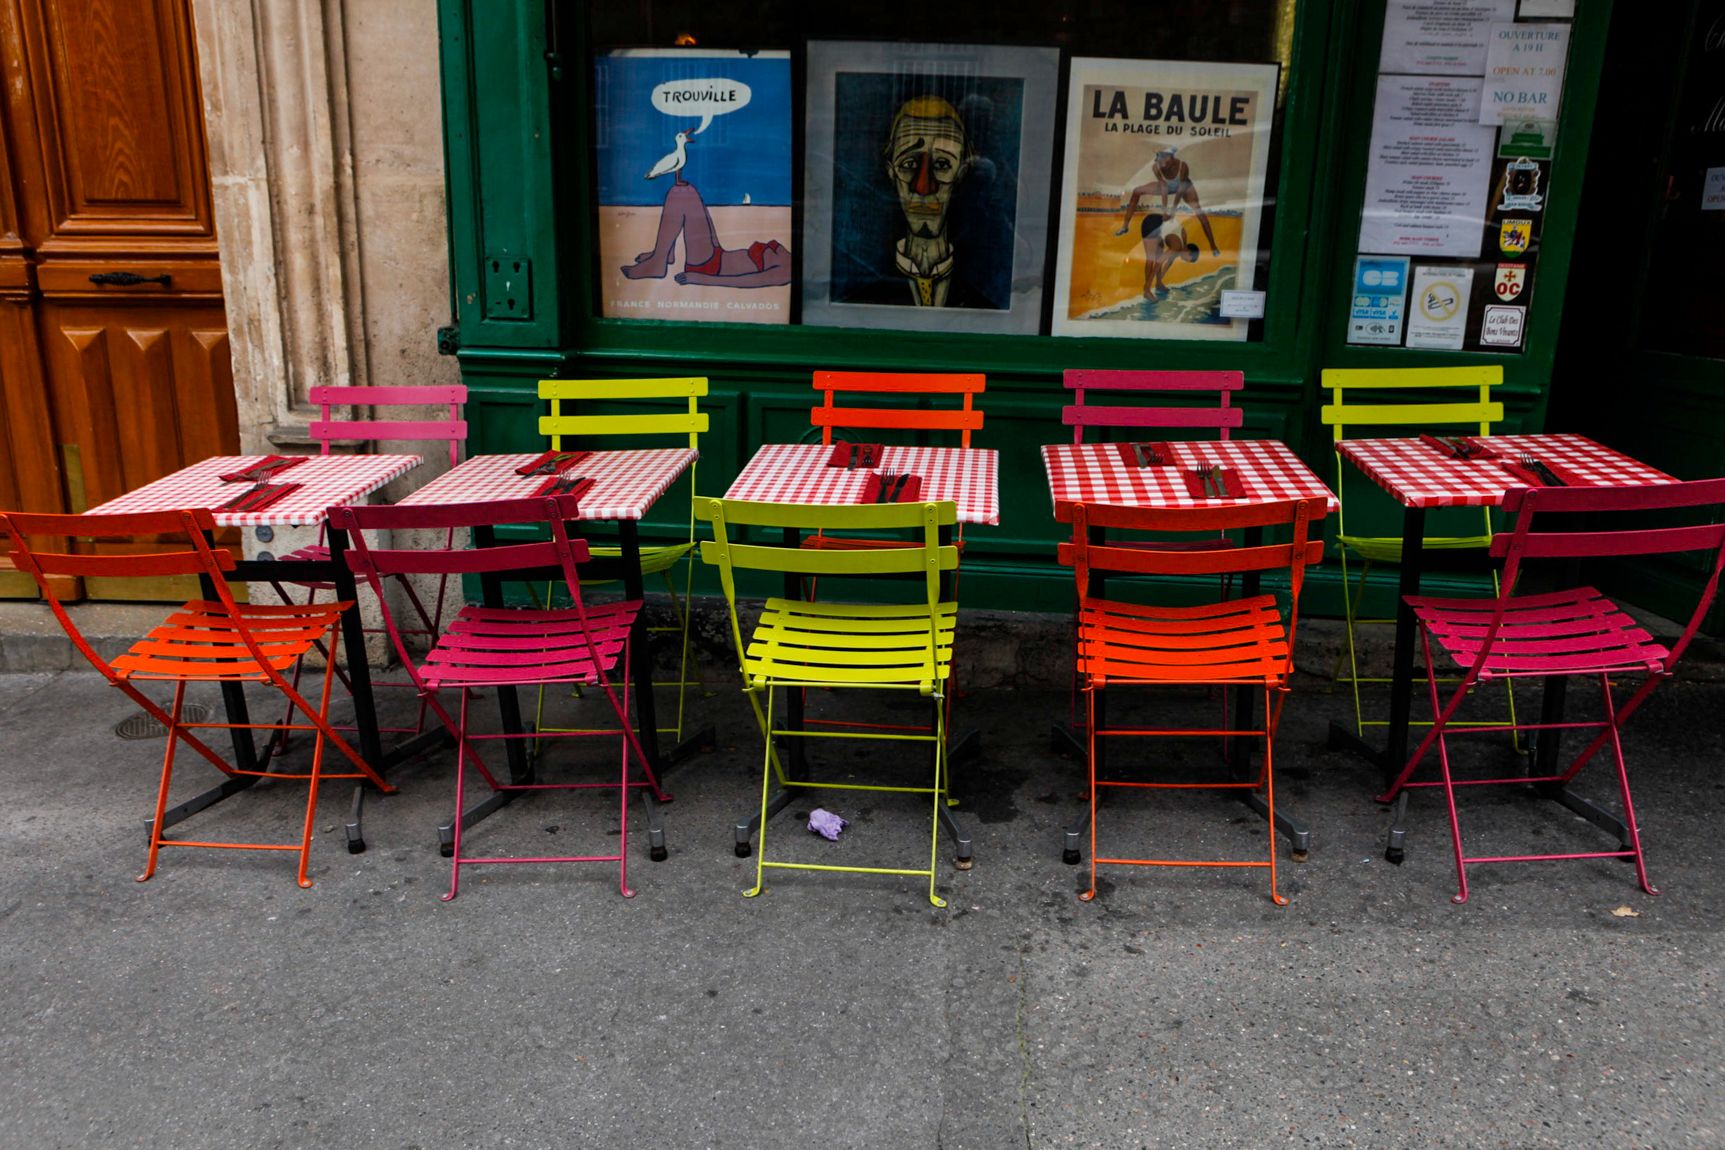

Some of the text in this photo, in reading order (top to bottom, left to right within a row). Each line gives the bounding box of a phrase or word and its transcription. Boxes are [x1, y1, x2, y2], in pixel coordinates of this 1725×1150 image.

[1498, 30, 1561, 41] OUVERTURE
[1511, 43, 1521, 53] A
[1523, 43, 1534, 53] 19
[1492, 66, 1521, 76] OPEN
[1522, 66, 1536, 76] AT
[1493, 90, 1548, 105] NO BAR
[1092, 89, 1250, 126] LA BAULE
[1104, 122, 1232, 138] LA PLAGE DU SOLEIL
[1496, 281, 1521, 297] OC
[609, 300, 781, 311] FRANCE NORMANDIE CALVADOS
